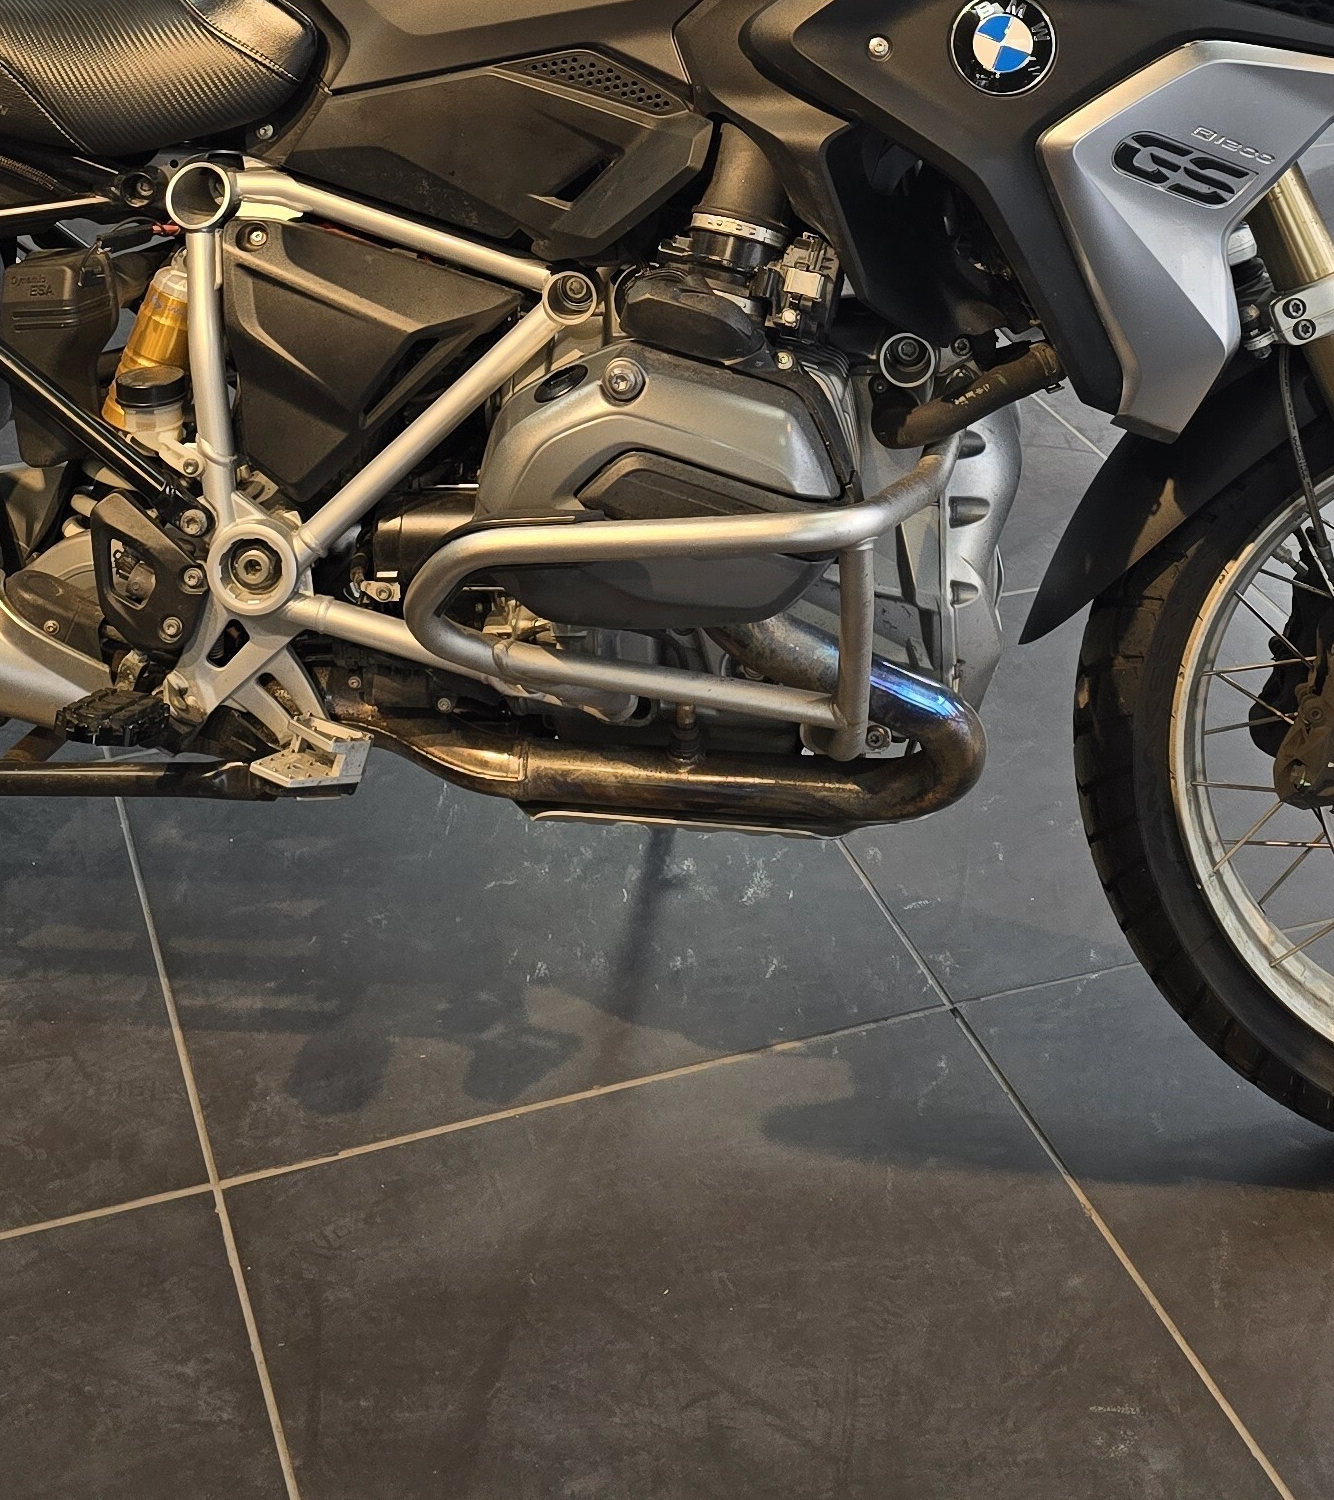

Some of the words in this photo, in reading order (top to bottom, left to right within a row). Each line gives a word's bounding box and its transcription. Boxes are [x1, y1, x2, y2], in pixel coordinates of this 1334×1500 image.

[974, 0, 1050, 41] BMW
[1114, 132, 1251, 206] GS
[29, 285, 54, 297] ESA
